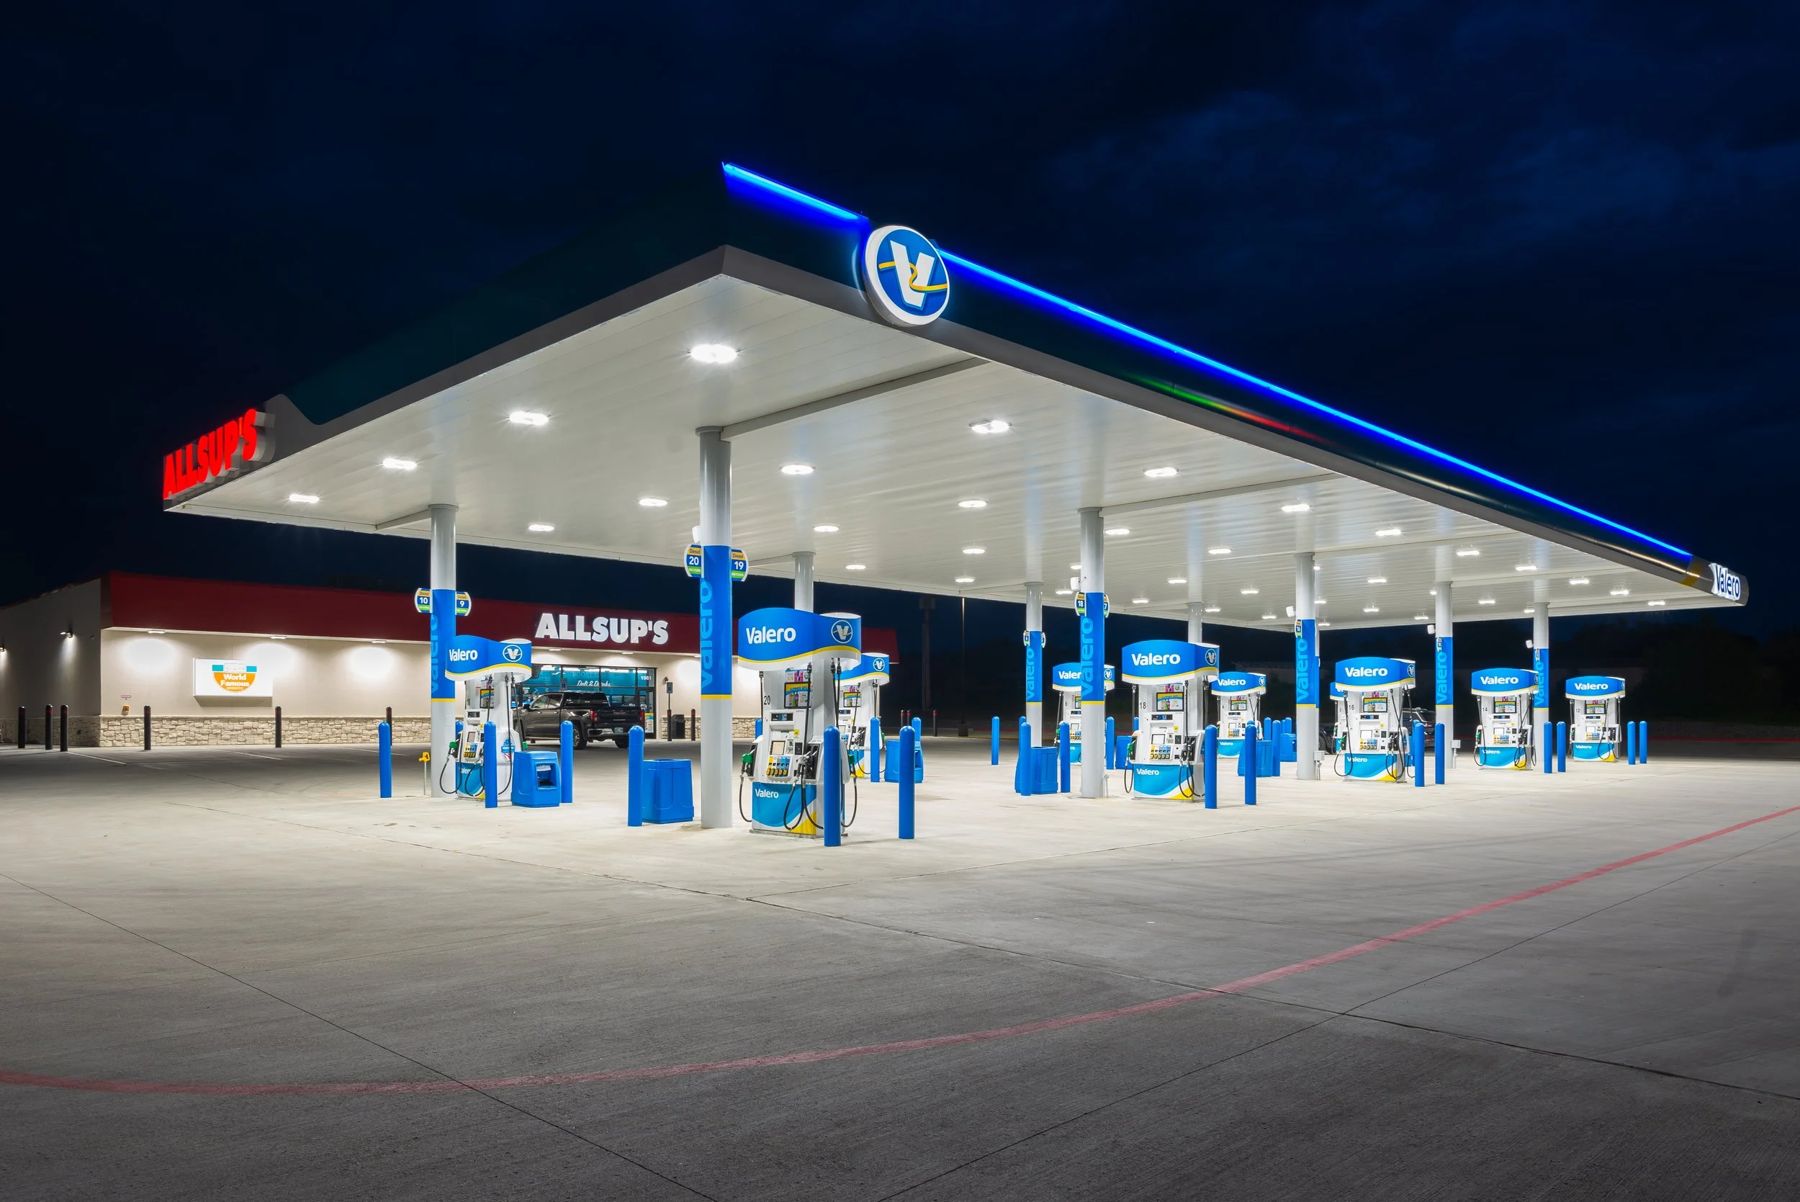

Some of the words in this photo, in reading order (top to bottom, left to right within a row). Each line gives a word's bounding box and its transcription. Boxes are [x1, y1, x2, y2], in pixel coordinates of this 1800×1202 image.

[162, 408, 258, 500] ALLSUP'S
[689, 556, 699, 566] 20
[734, 561, 744, 570] 19
[1711, 563, 1741, 600] Valero
[535, 613, 669, 645] ALLSUP'S
[745, 626, 797, 644] Valero
[449, 649, 478, 661] Valero
[1131, 653, 1181, 666] Valero
[1058, 671, 1081, 679] Valer
[1296, 638, 1309, 702] Valero
[1345, 667, 1388, 677] Valero
[223, 672, 247, 680] World
[1480, 676, 1519, 685] Valero
[1217, 679, 1246, 687] Valero
[1574, 682, 1608, 690] Valero
[763, 695, 770, 705] 20
[755, 788, 779, 798] Valero
